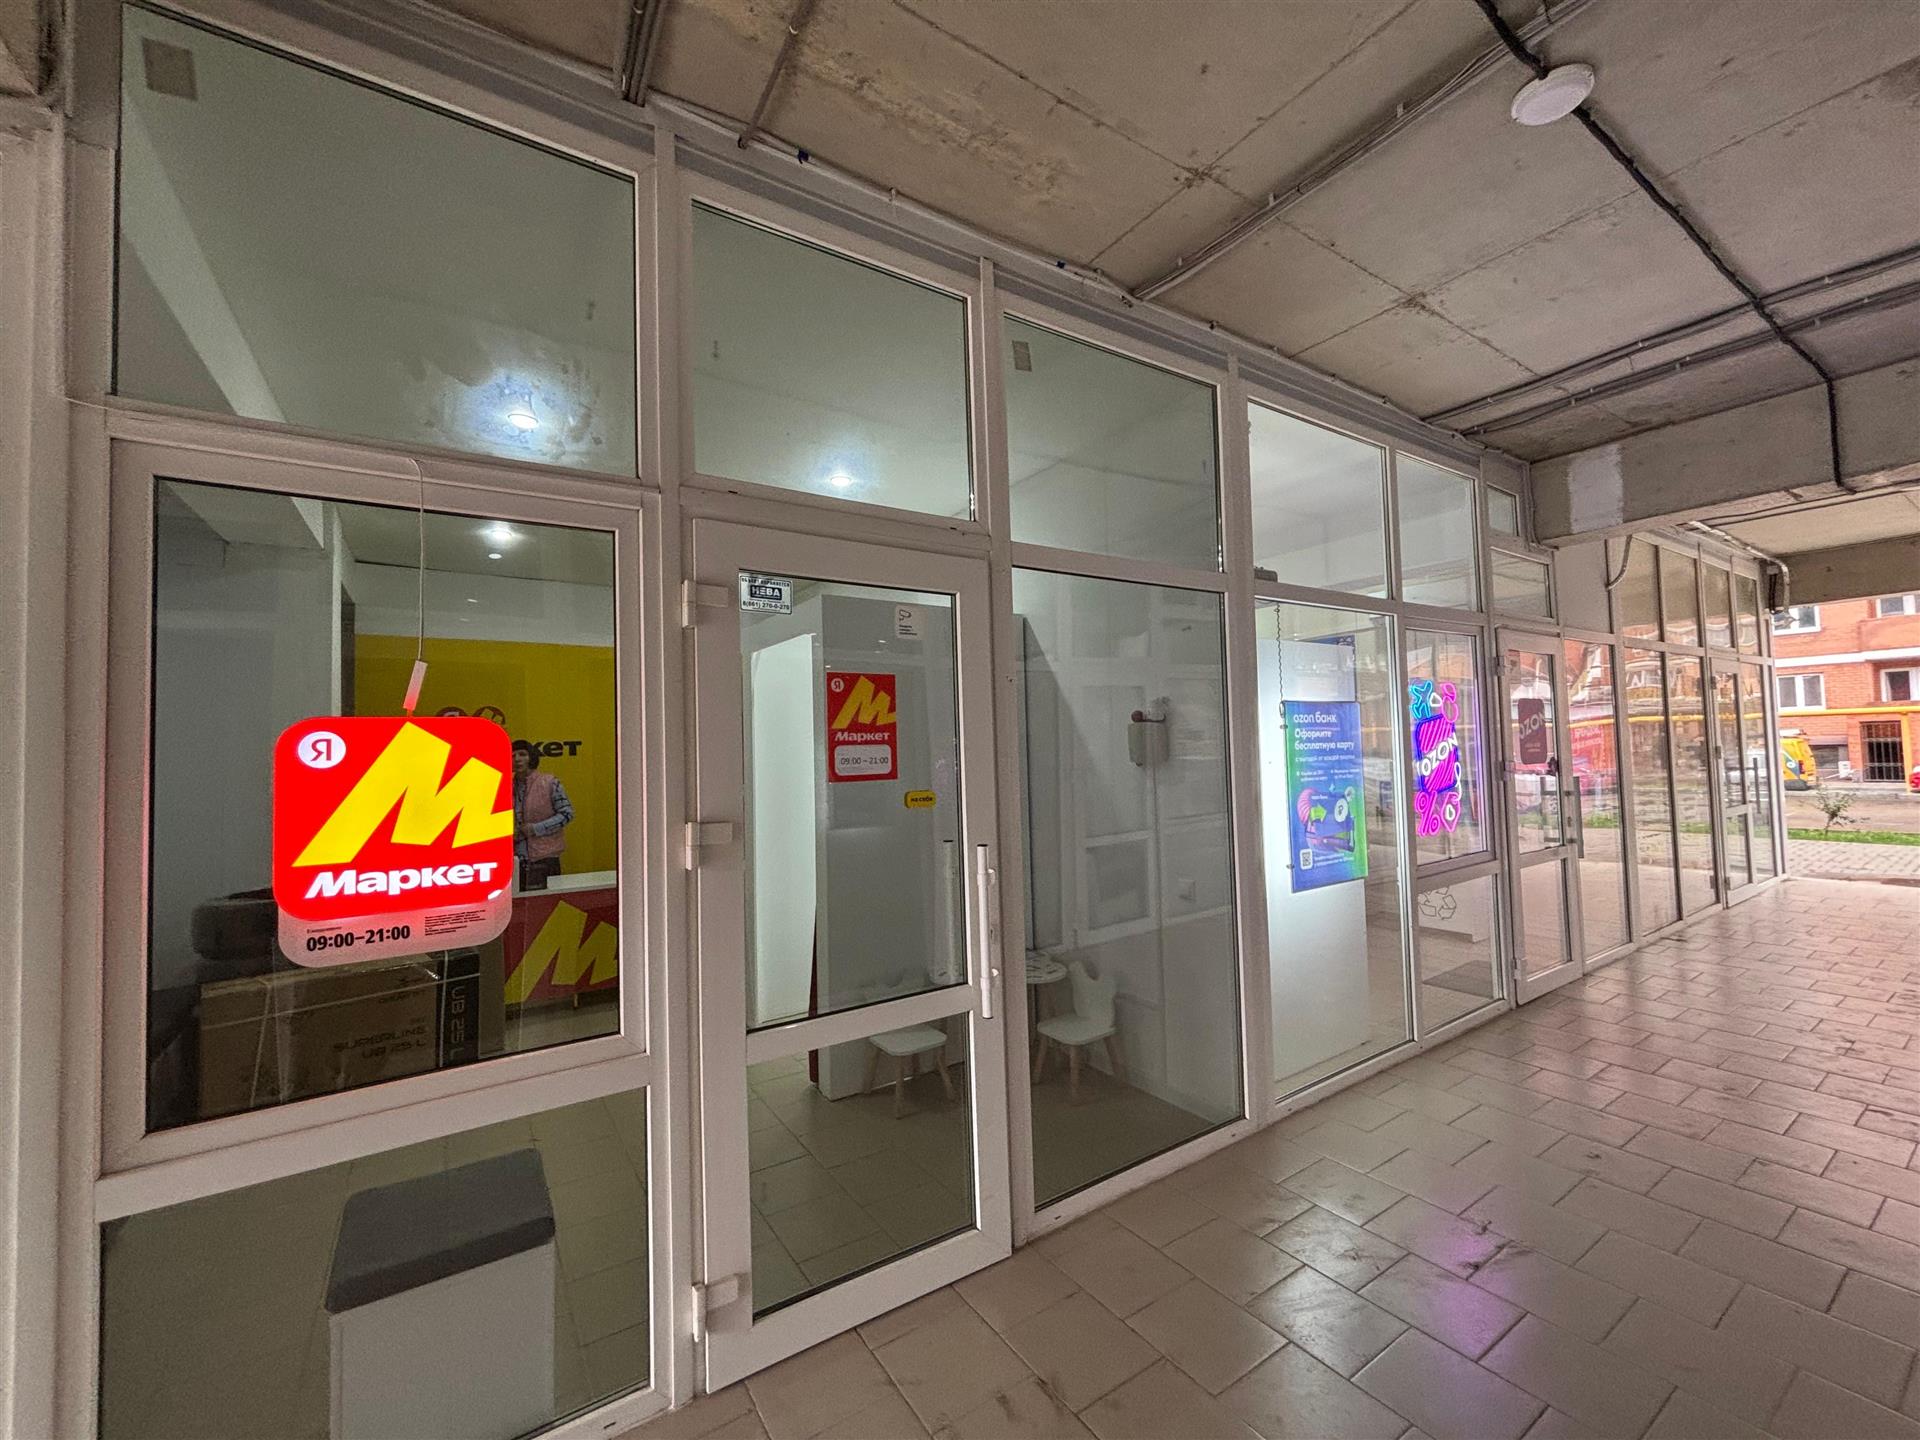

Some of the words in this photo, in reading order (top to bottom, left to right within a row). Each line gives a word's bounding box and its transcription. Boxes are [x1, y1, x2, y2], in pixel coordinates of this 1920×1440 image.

[752, 586, 780, 597] НЕВА
[1293, 714, 1314, 723] ozon
[1314, 711, 1337, 723] банк
[834, 731, 891, 742] Маркет
[1294, 729, 1332, 740] Оформите
[309, 738, 333, 763] Я
[1336, 742, 1355, 751] карту
[1421, 732, 1458, 776] OZON
[868, 756, 889, 765] 21:00
[303, 862, 498, 900] Маркет
[450, 985, 465, 1015] UB
